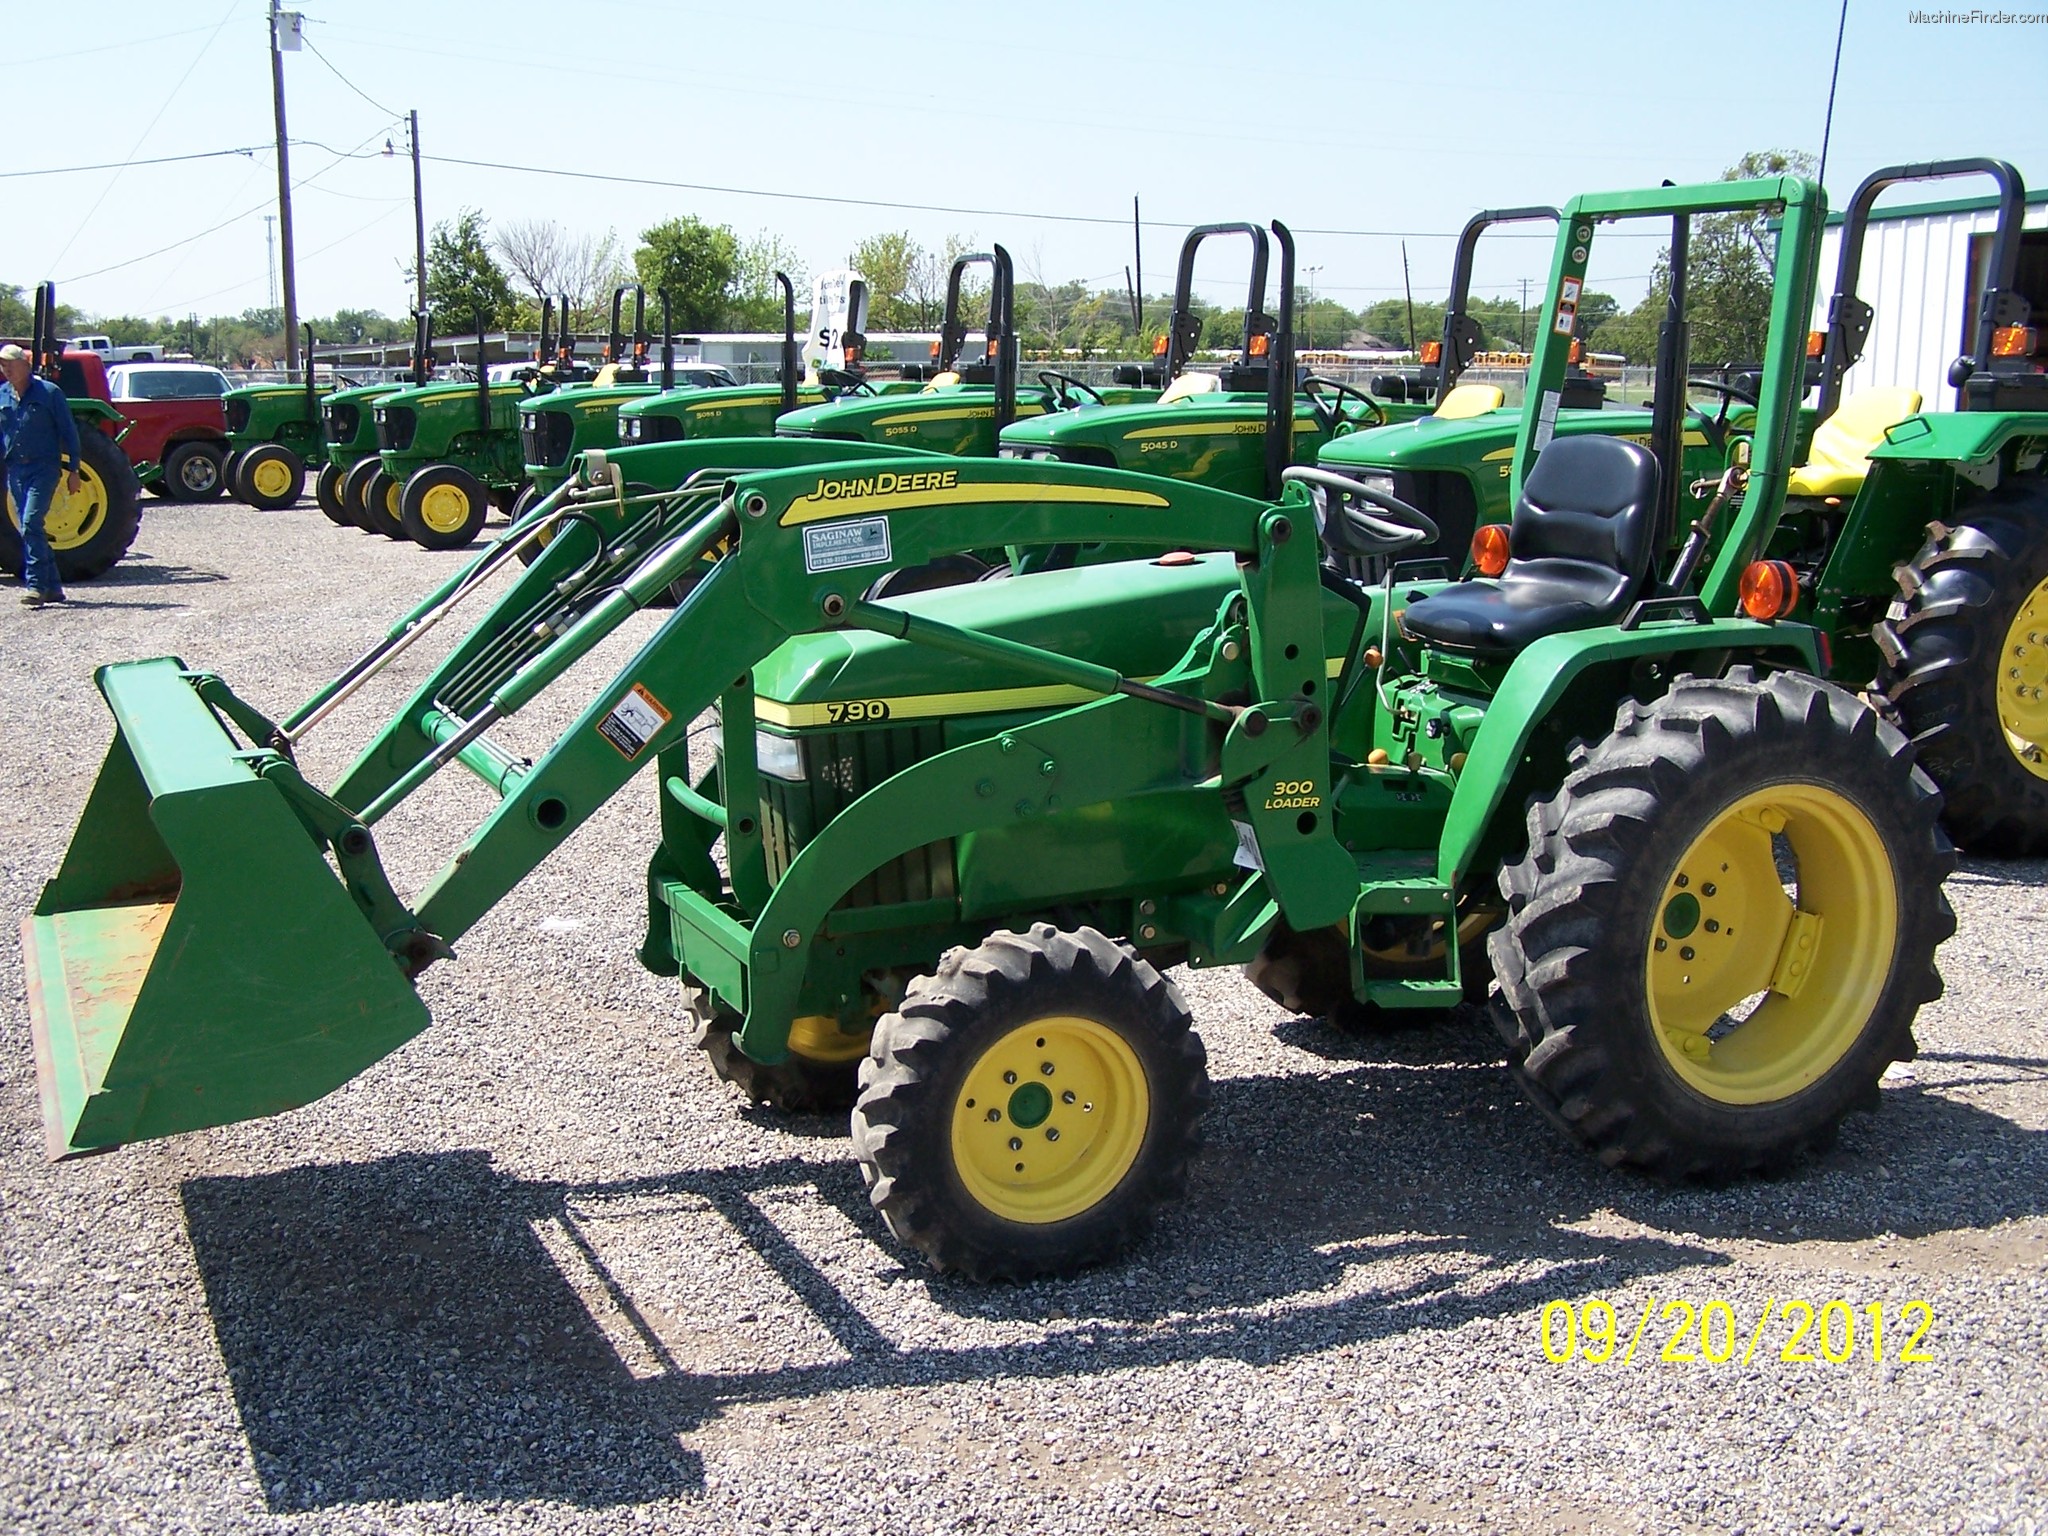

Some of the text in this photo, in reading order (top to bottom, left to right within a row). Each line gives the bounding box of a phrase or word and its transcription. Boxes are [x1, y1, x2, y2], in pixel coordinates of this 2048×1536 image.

[1232, 424, 1257, 434] JOHN
[1140, 440, 1178, 453] 5045 D
[807, 470, 958, 501] JOHN DEERE
[811, 527, 863, 543] SAGINAW
[828, 700, 887, 722] 790
[1273, 780, 1314, 796] 300
[1264, 797, 1320, 809] LOADER
